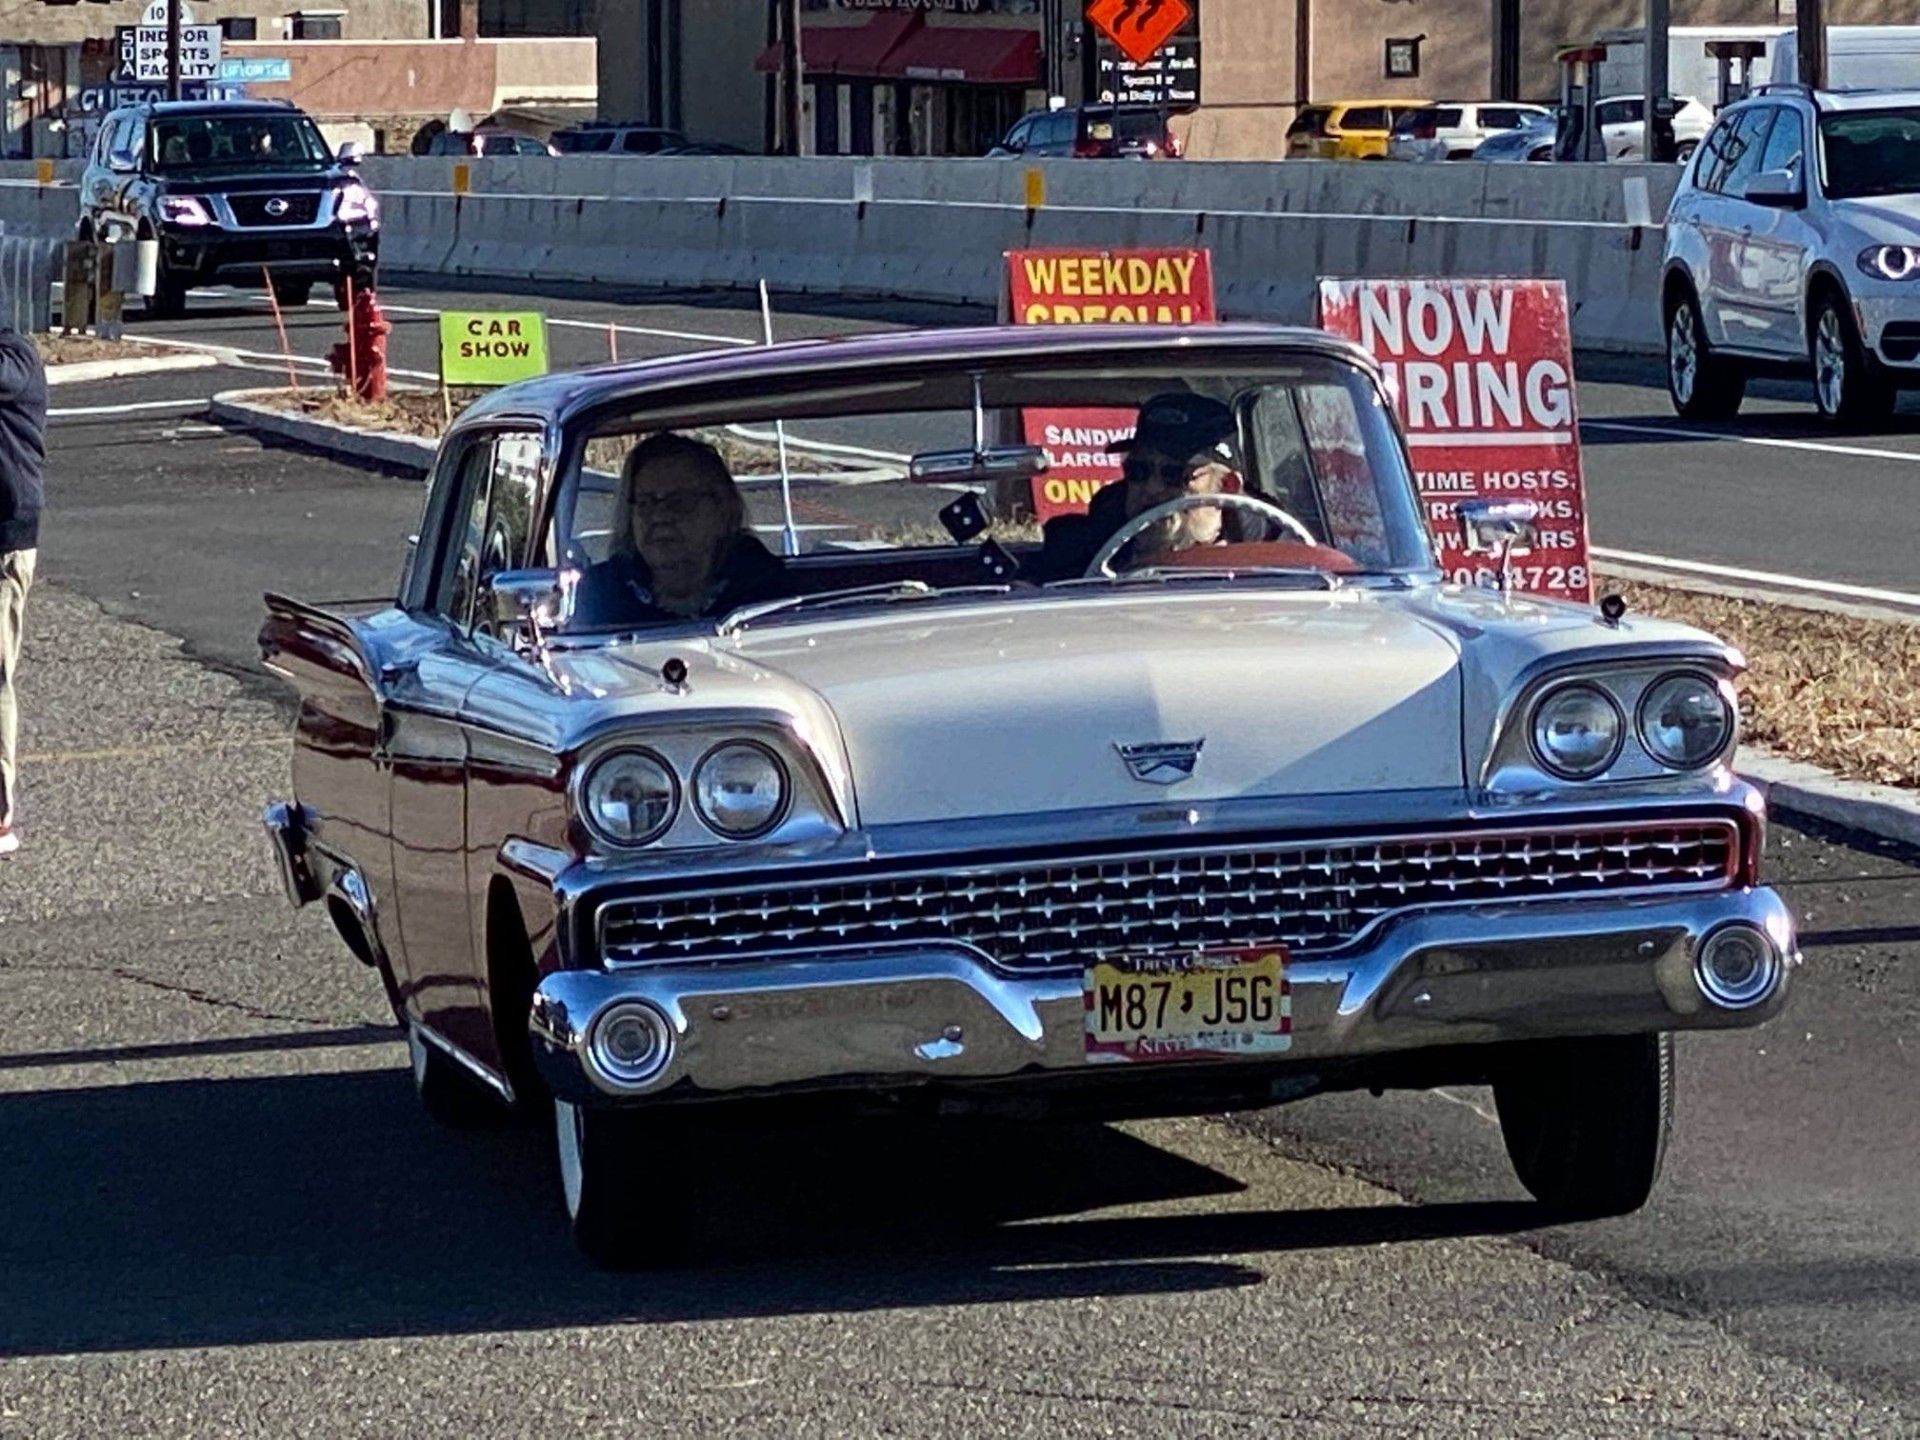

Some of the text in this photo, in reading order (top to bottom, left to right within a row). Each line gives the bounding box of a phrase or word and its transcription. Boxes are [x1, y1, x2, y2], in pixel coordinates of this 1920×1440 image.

[139, 30, 208, 42] INDOR
[140, 63, 216, 76] FACLITY
[1023, 257, 1196, 296] WEEKDAY
[468, 320, 521, 336] CAR
[1358, 282, 1514, 356] NOW
[460, 341, 530, 358] SHOW
[1380, 359, 1572, 428] IRING
[1100, 975, 1273, 1032] M87 JSG
